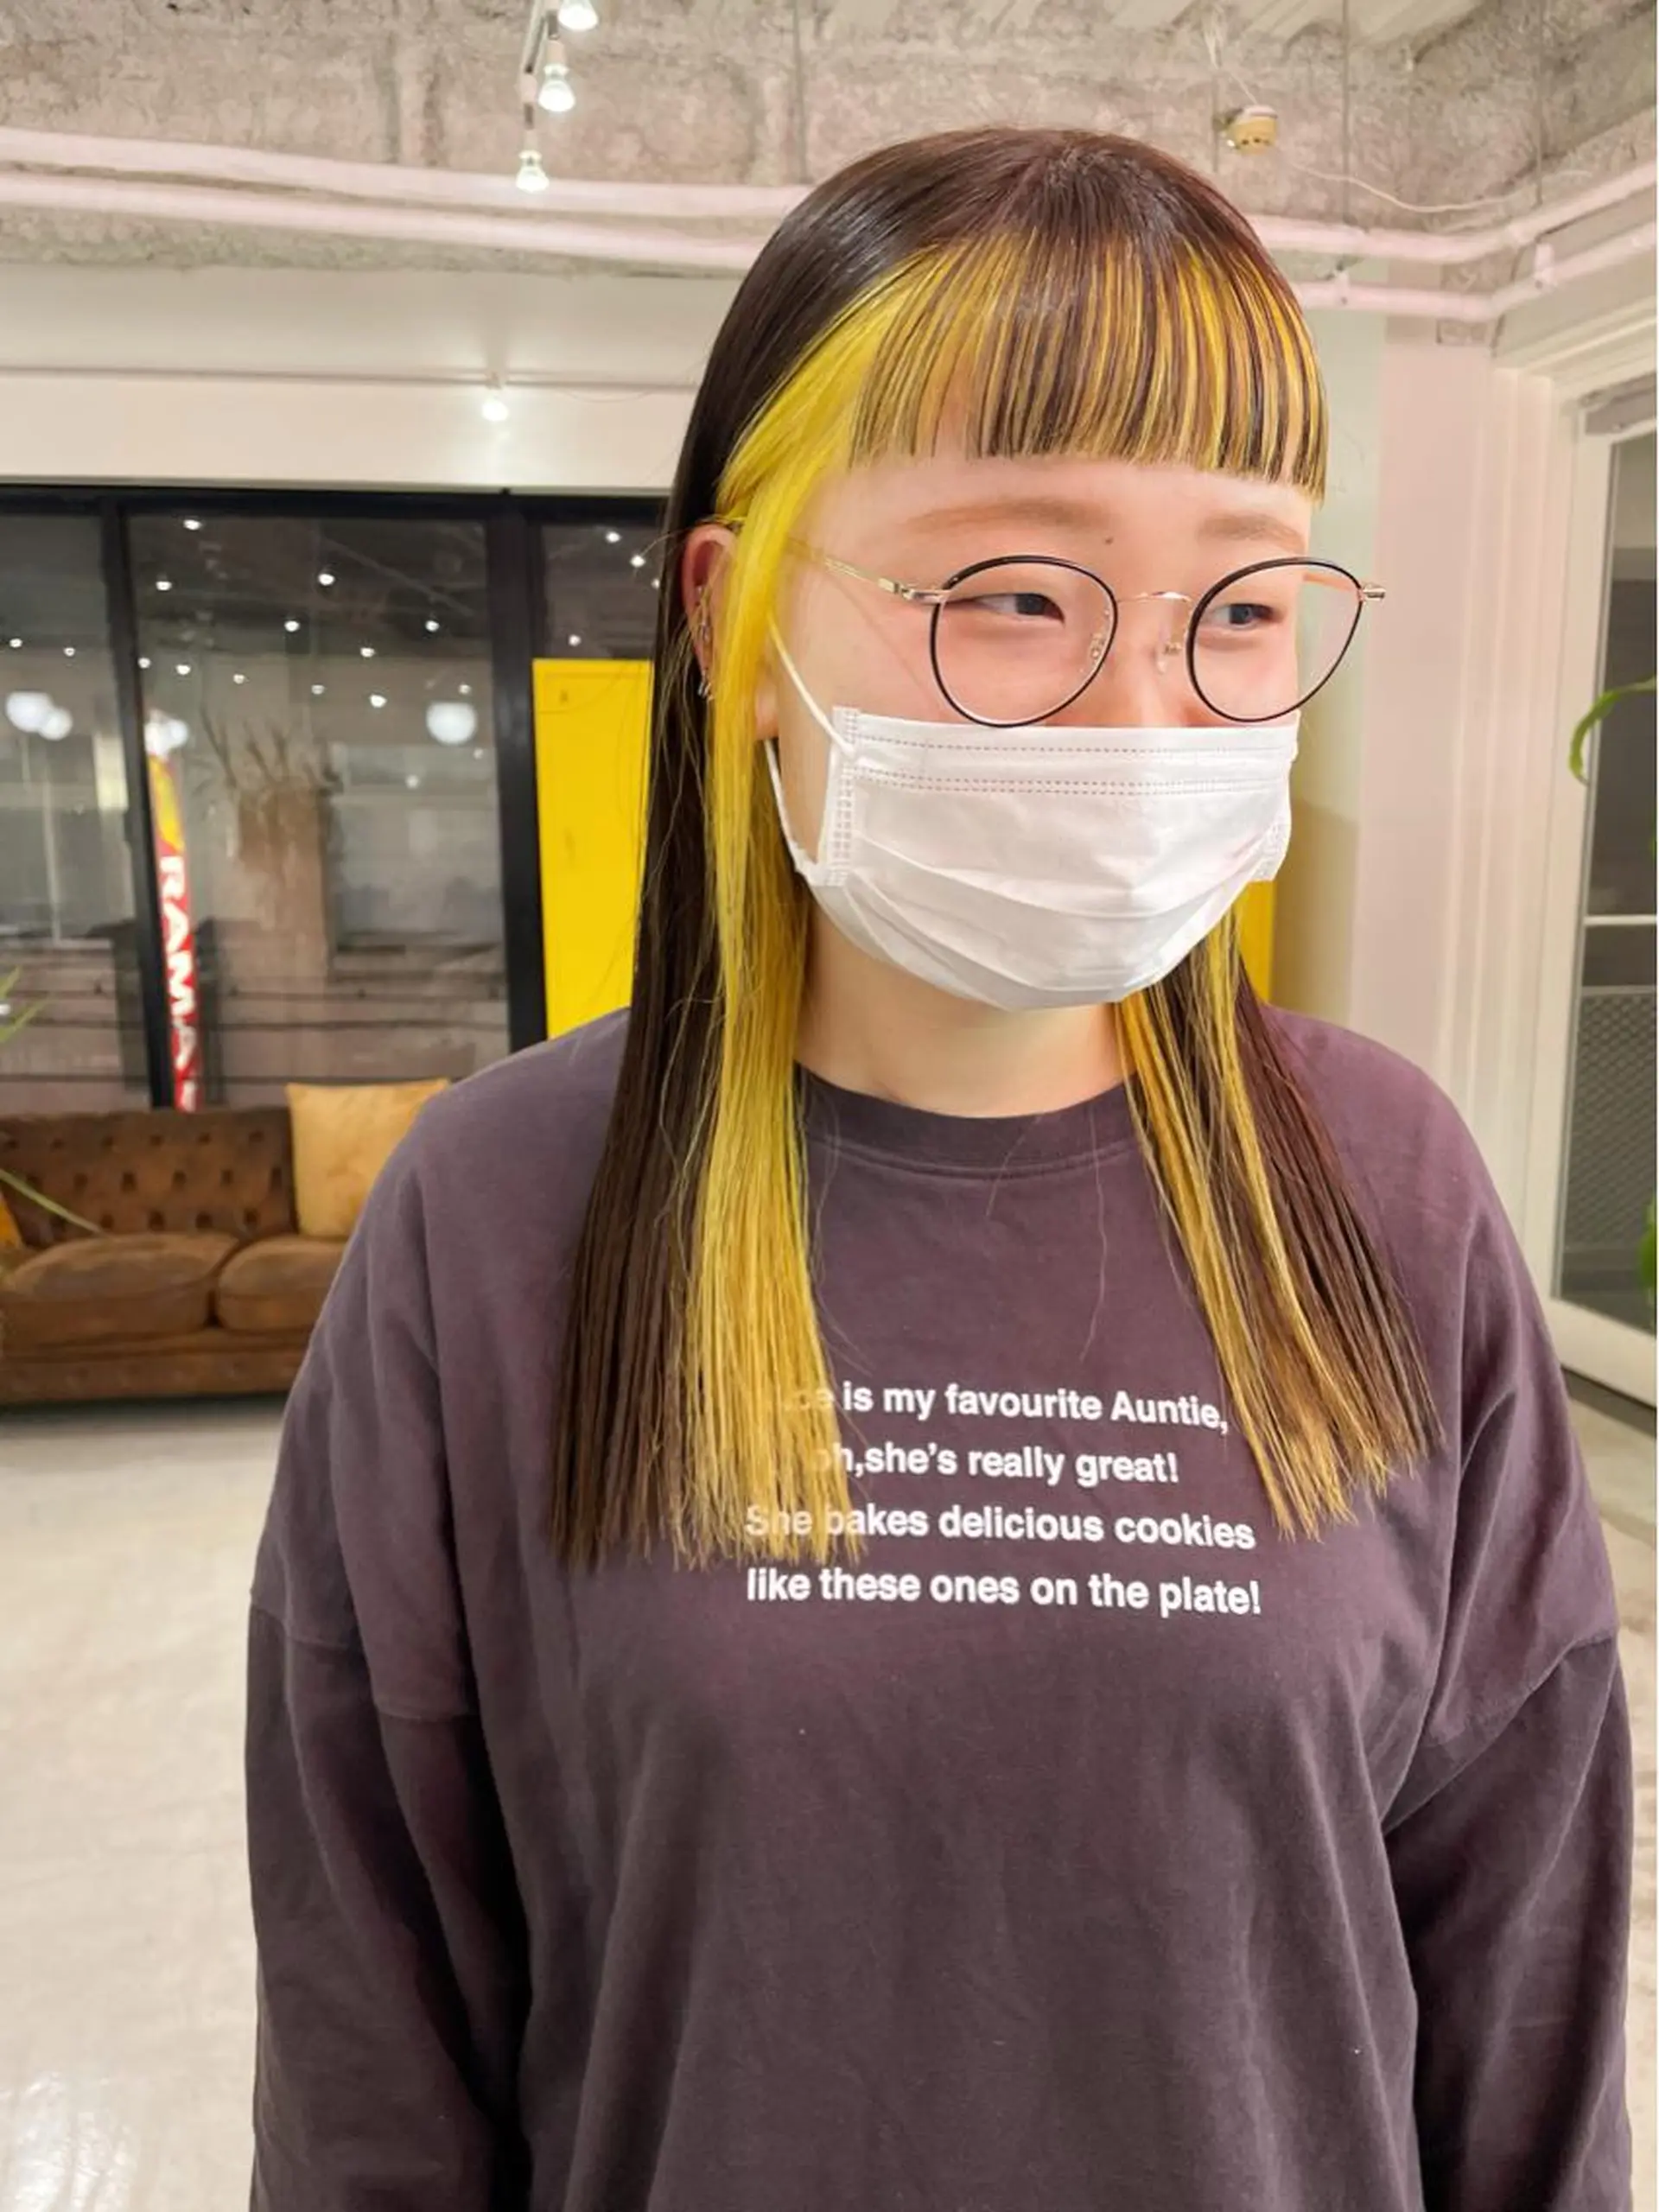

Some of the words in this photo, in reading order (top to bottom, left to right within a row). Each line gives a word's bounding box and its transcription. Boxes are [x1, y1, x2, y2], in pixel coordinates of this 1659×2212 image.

[842, 1380, 874, 1412] is
[883, 1388, 937, 1421] my
[944, 1382, 1103, 1421] favourite
[1110, 1390, 1229, 1435] Auntie,
[968, 1446, 1065, 1486] really
[1075, 1452, 1179, 1488] great!
[825, 1503, 930, 1537] bakes
[938, 1503, 1106, 1542] delicious
[1114, 1512, 1256, 1550] cookies
[747, 1567, 811, 1601] like
[818, 1567, 921, 1602] these
[930, 1574, 1020, 1605] ones
[1029, 1576, 1078, 1605] on
[1087, 1573, 1150, 1609] the
[1159, 1575, 1262, 1618] plate!
